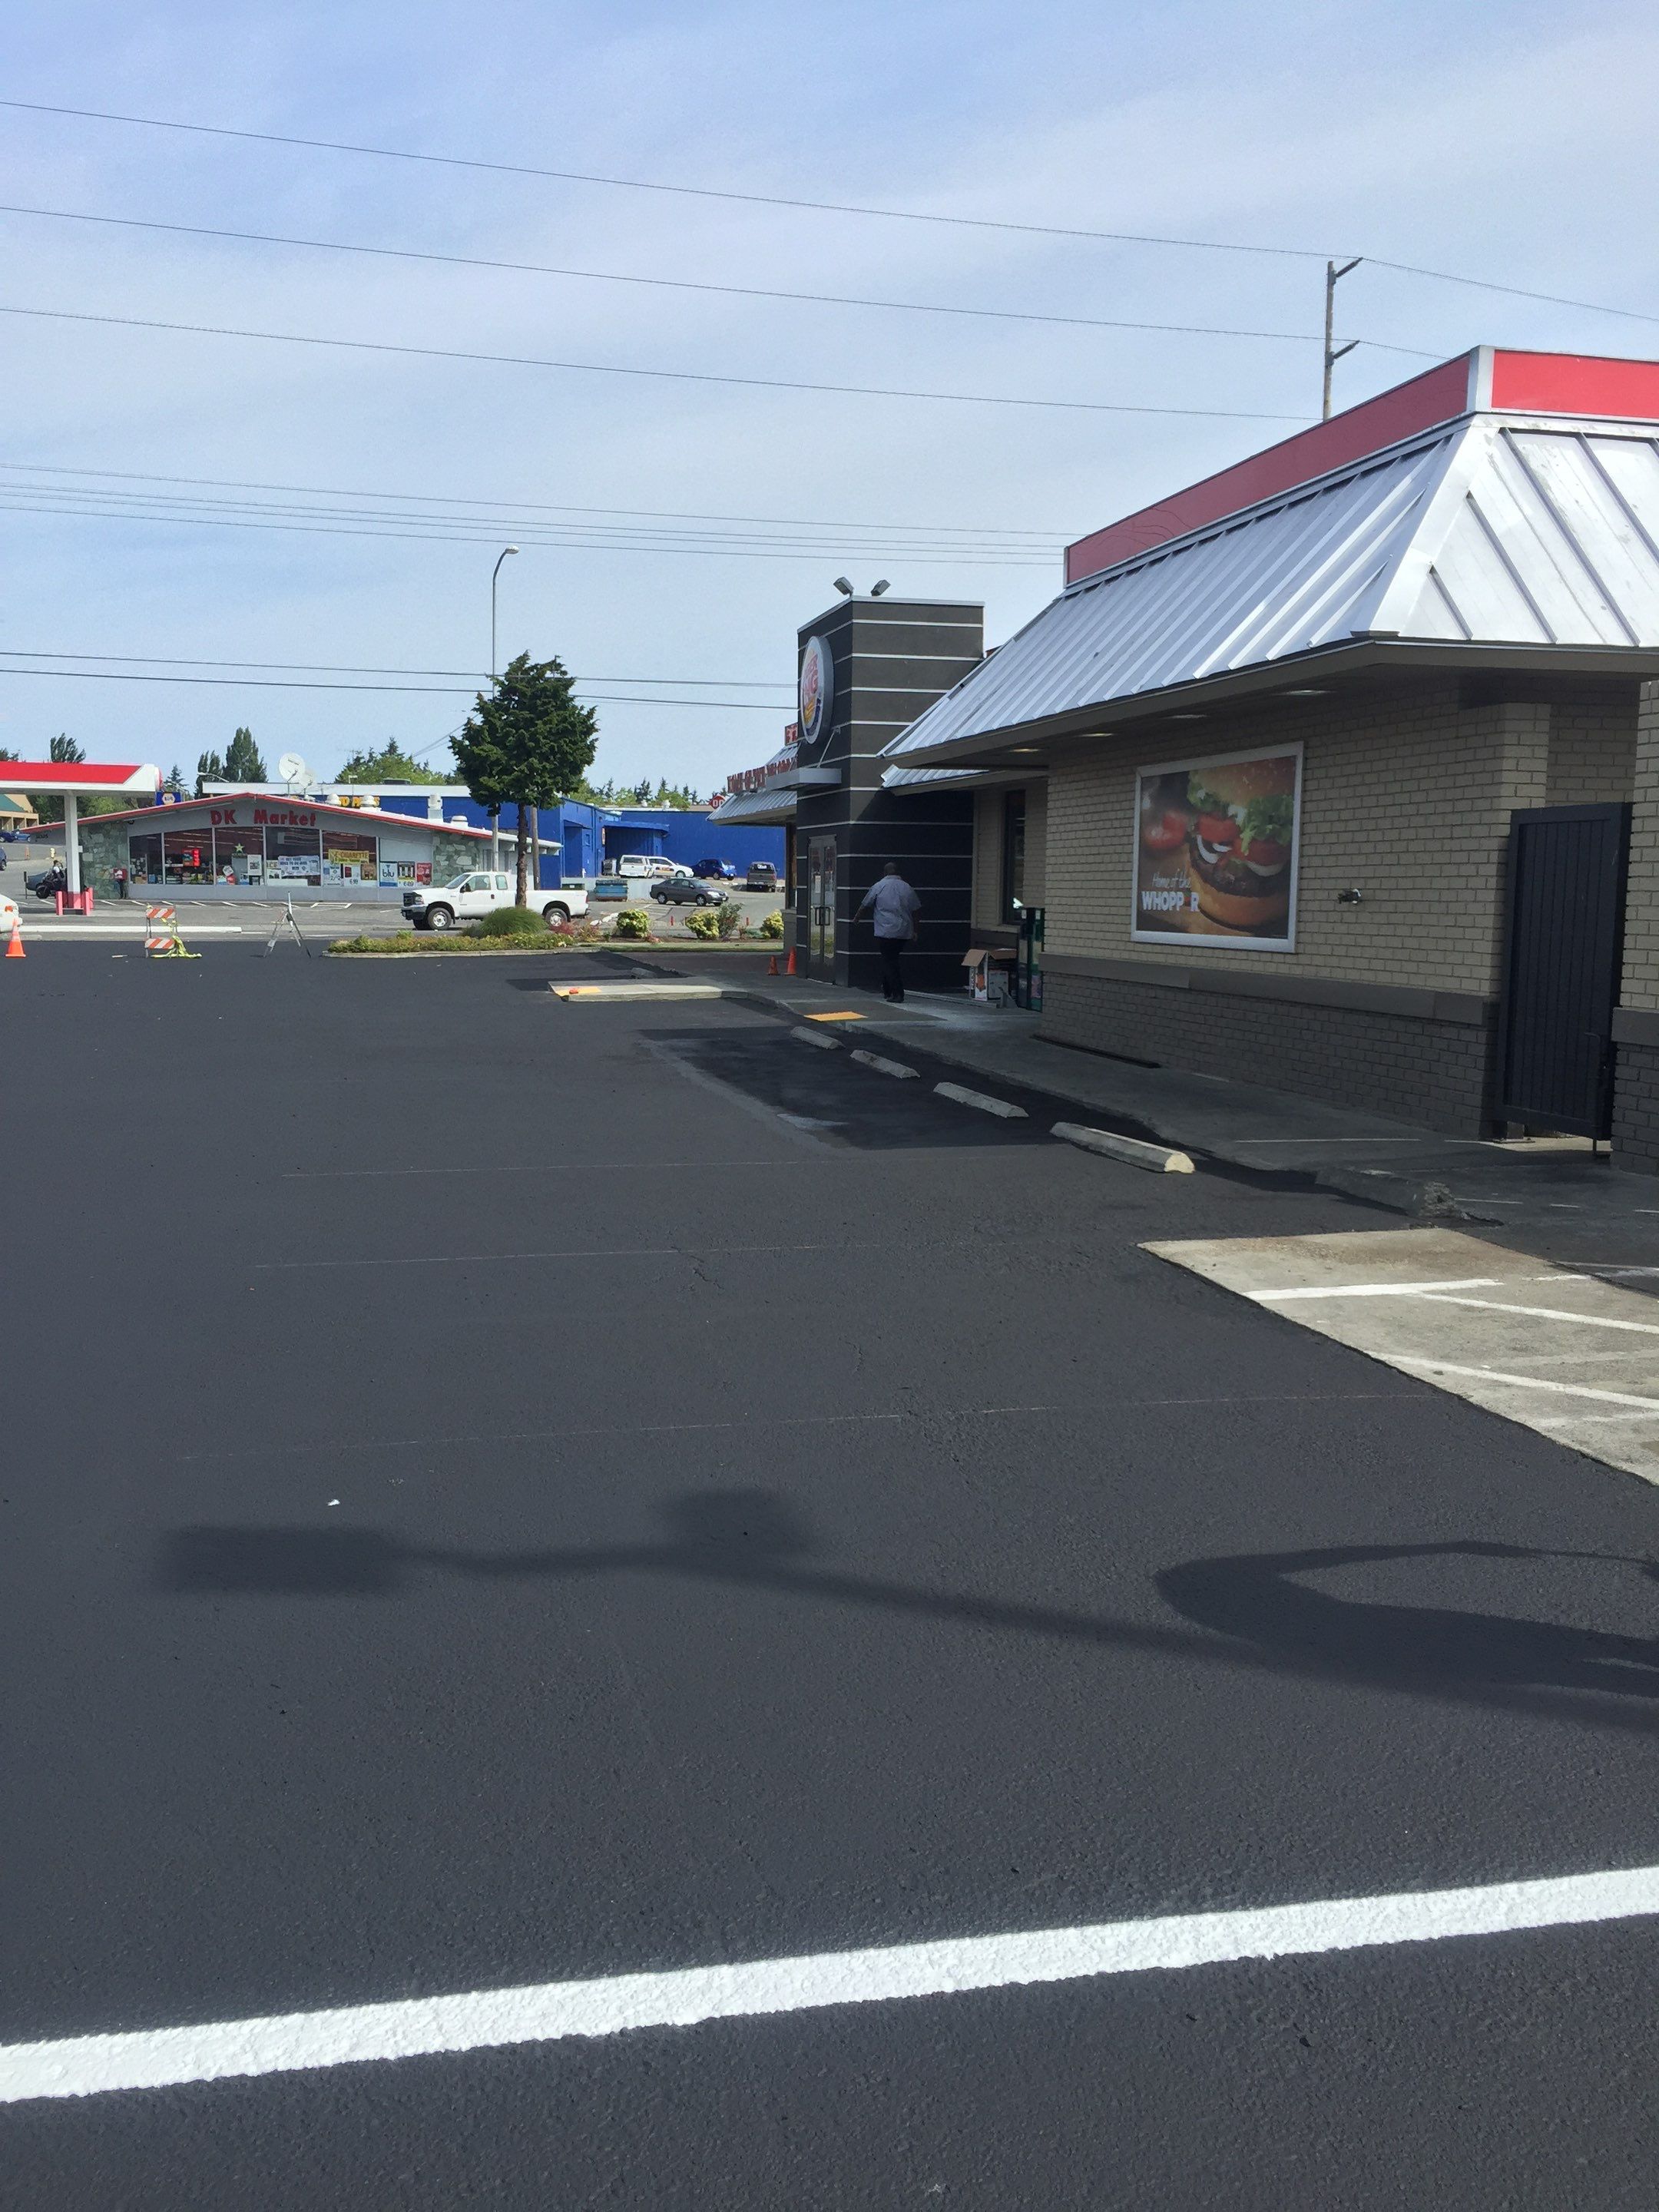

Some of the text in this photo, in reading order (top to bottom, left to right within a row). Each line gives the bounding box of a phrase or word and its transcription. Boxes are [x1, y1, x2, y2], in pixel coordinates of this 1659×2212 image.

[210, 809, 316, 826] DK Market
[382, 869, 395, 878] blu
